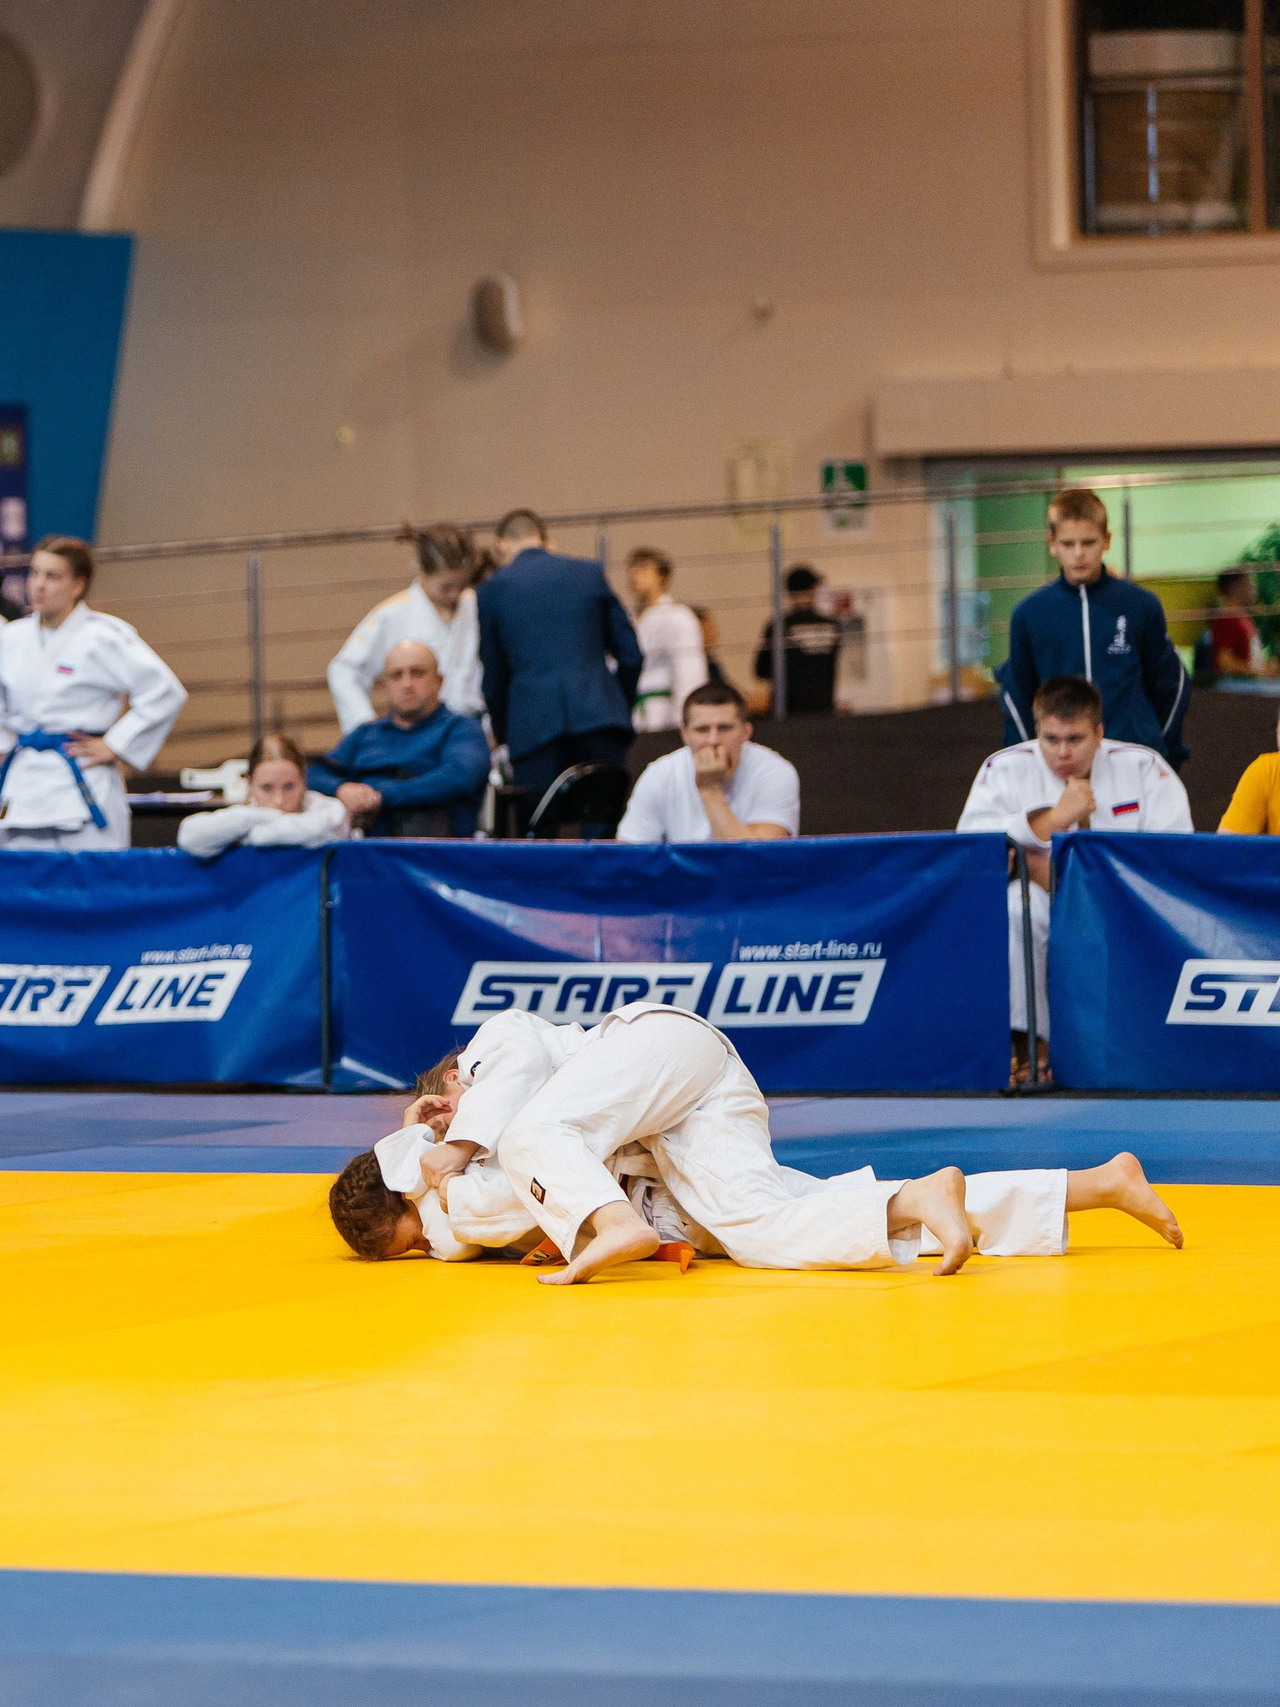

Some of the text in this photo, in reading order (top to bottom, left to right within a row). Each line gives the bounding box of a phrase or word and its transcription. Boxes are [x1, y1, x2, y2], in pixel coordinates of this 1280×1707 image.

[739, 941, 882, 961] www.start-line.ru
[114, 973, 226, 1012] LINE
[472, 973, 864, 1012] START LINE
